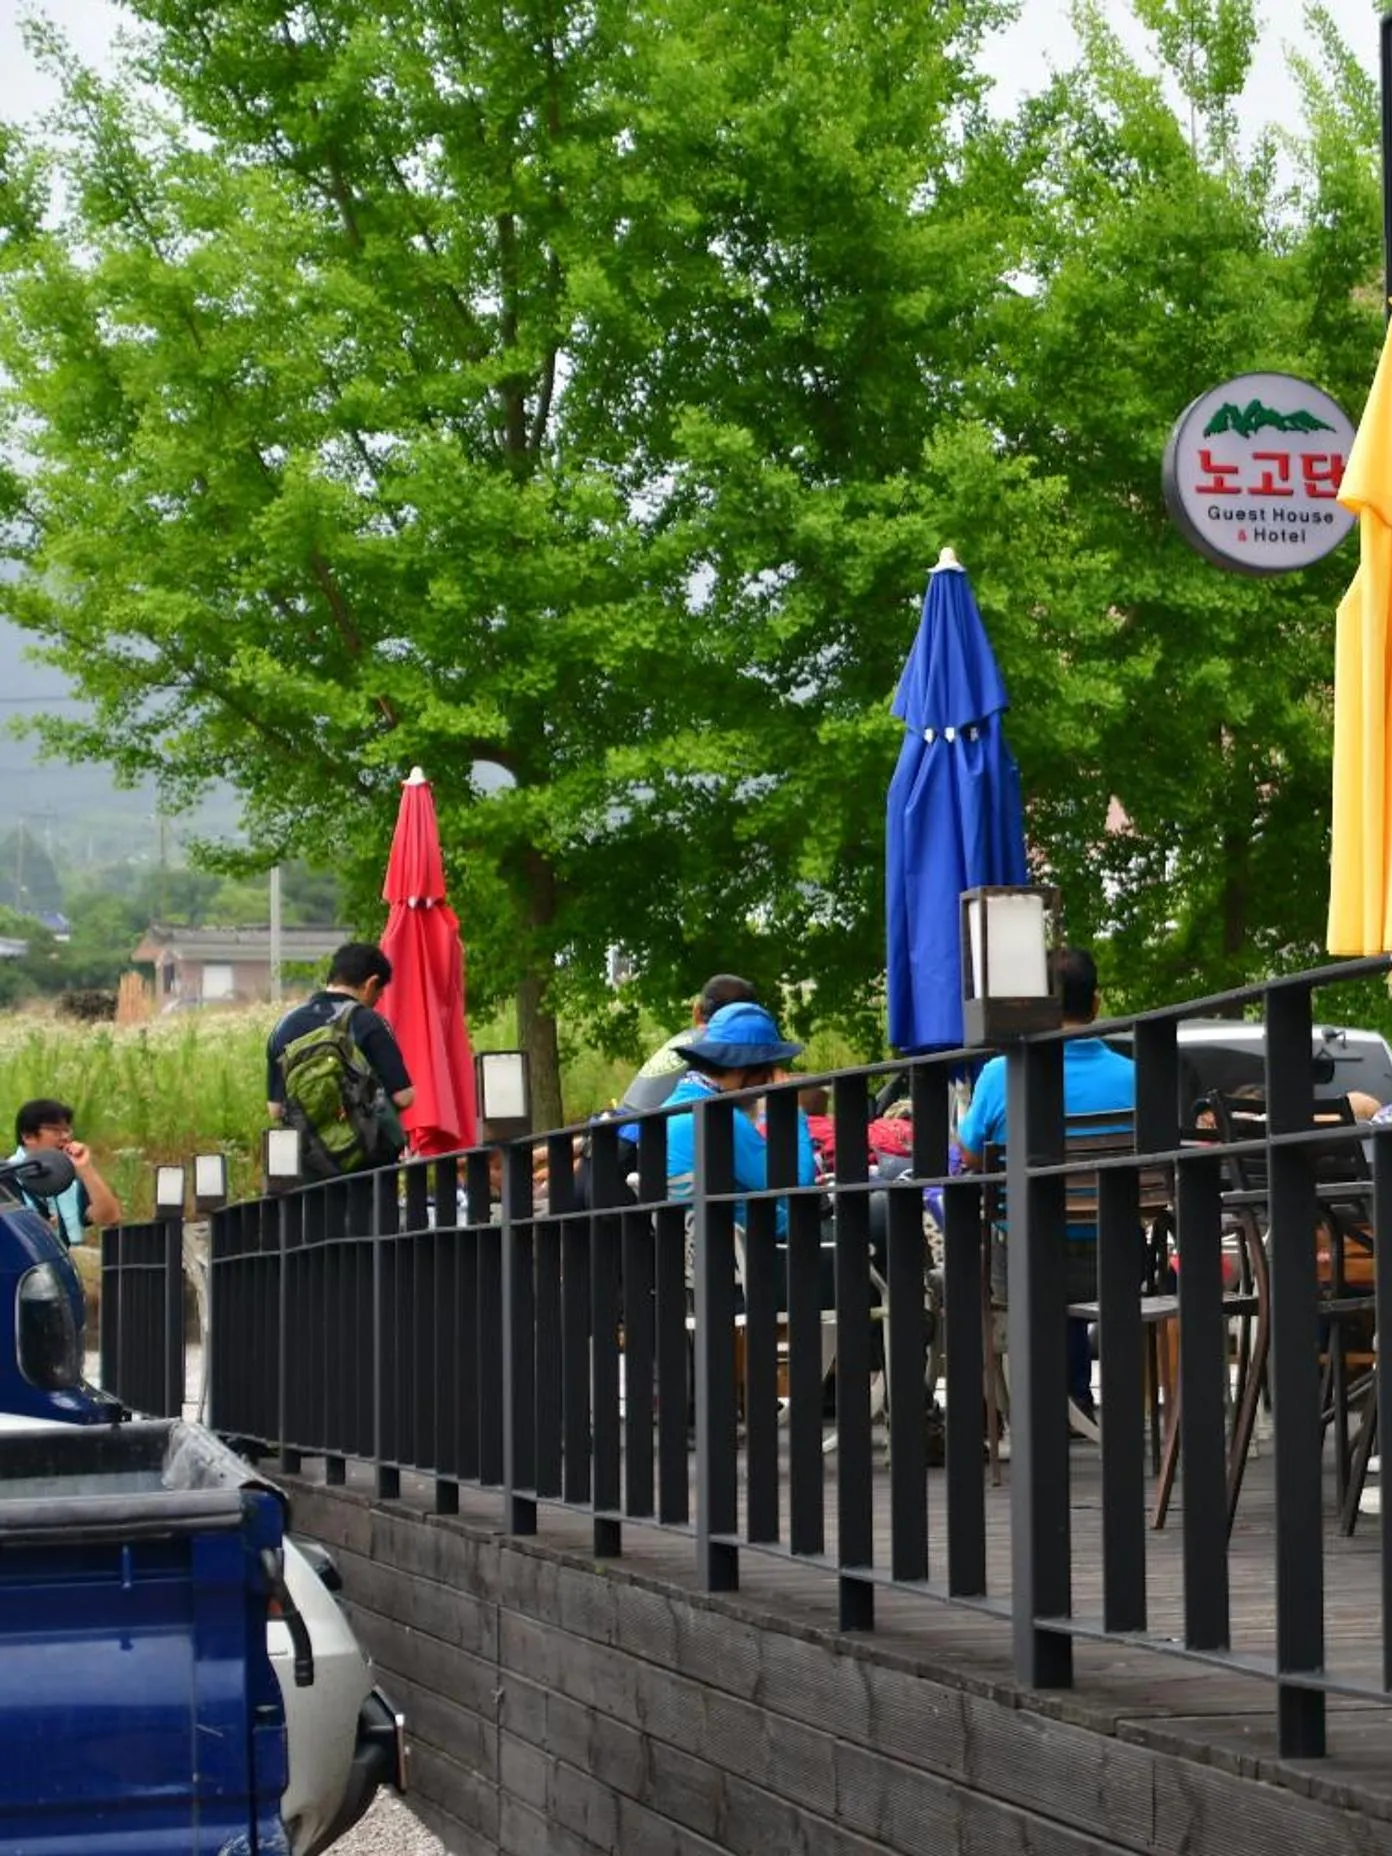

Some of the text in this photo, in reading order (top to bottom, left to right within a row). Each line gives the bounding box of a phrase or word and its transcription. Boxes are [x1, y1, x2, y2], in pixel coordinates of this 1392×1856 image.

[1195, 450, 1346, 499] 노고단
[1207, 505, 1334, 525] Guest House
[1253, 527, 1306, 544] Hotel
